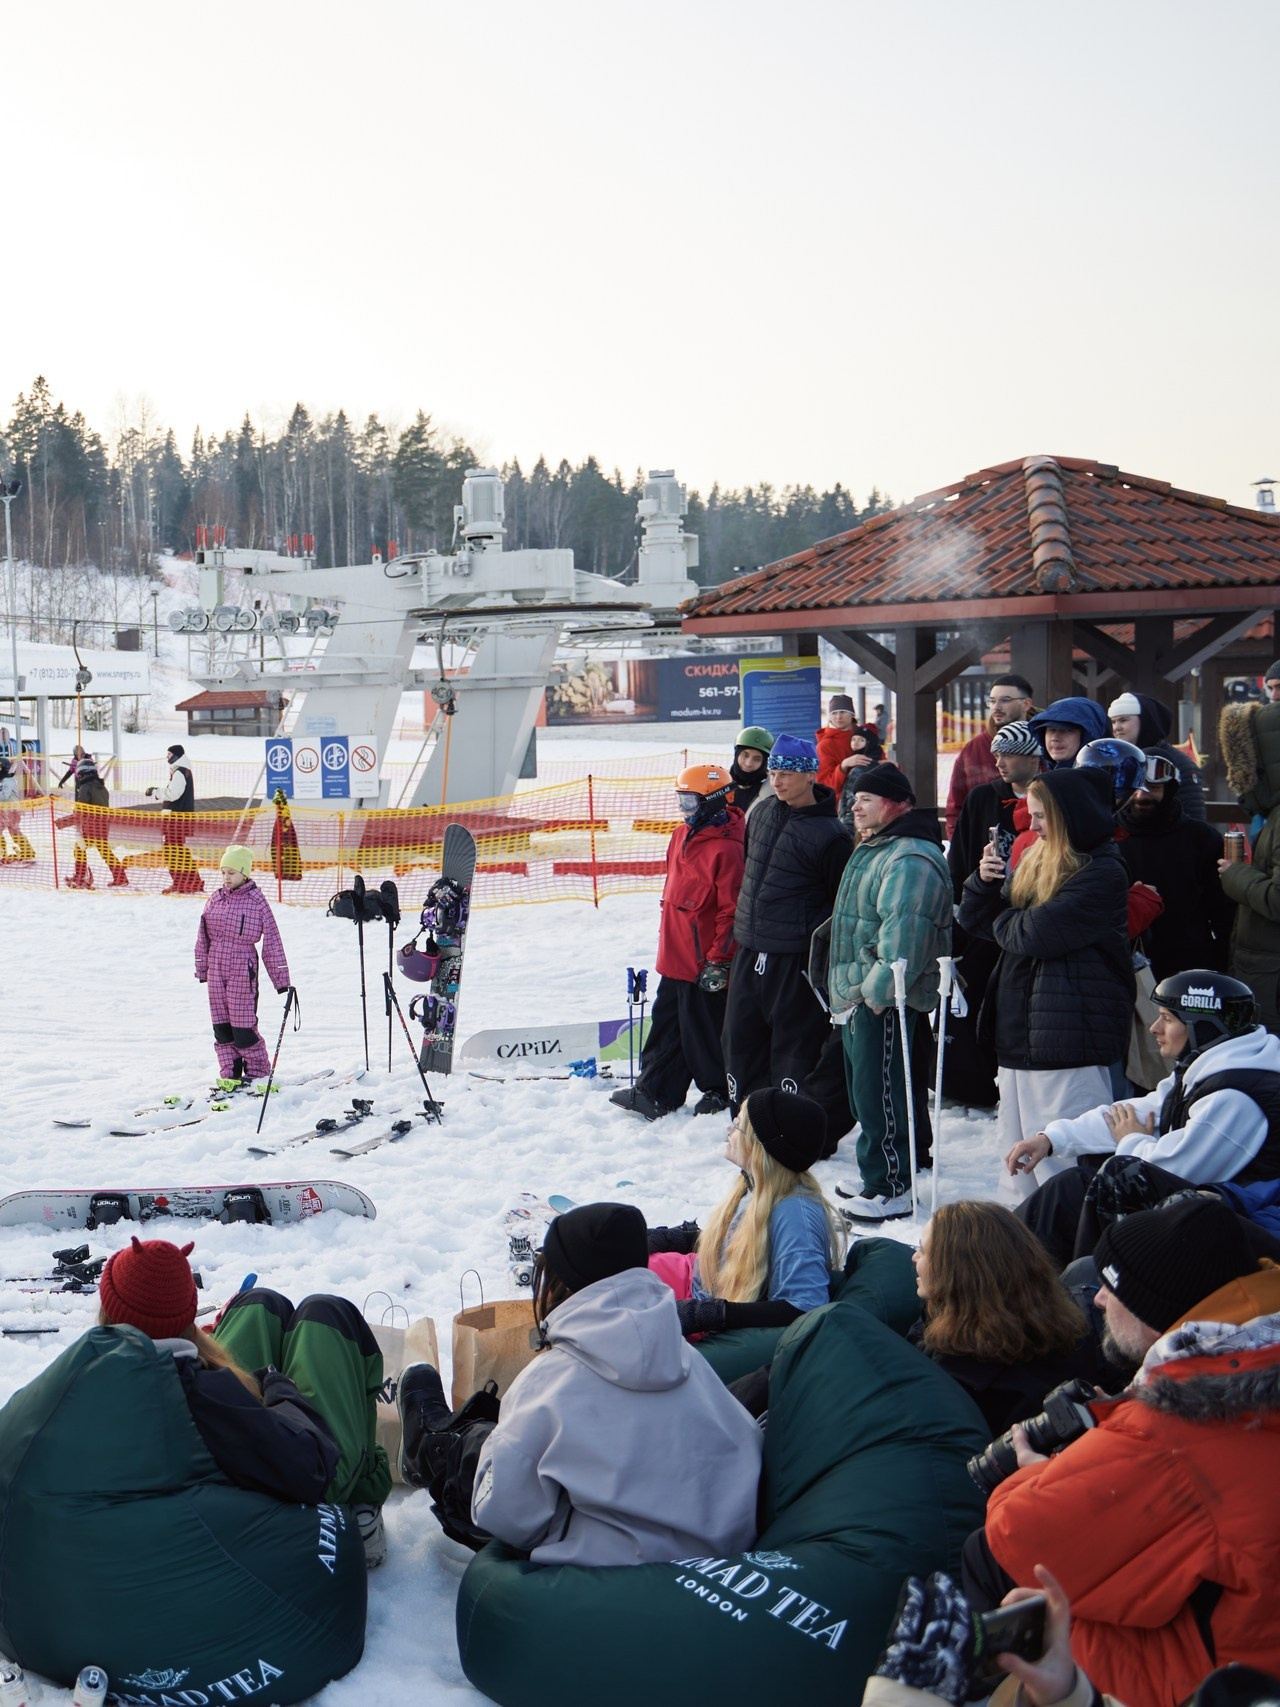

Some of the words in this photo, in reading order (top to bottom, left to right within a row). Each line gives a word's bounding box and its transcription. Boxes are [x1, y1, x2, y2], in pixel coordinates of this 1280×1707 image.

[684, 664, 739, 678] СКИДКА
[1181, 994, 1222, 1010] GORILLA
[675, 1575, 748, 1621] LONDON
[766, 1586, 848, 1650] TEA
[208, 1659, 285, 1701] TEA
